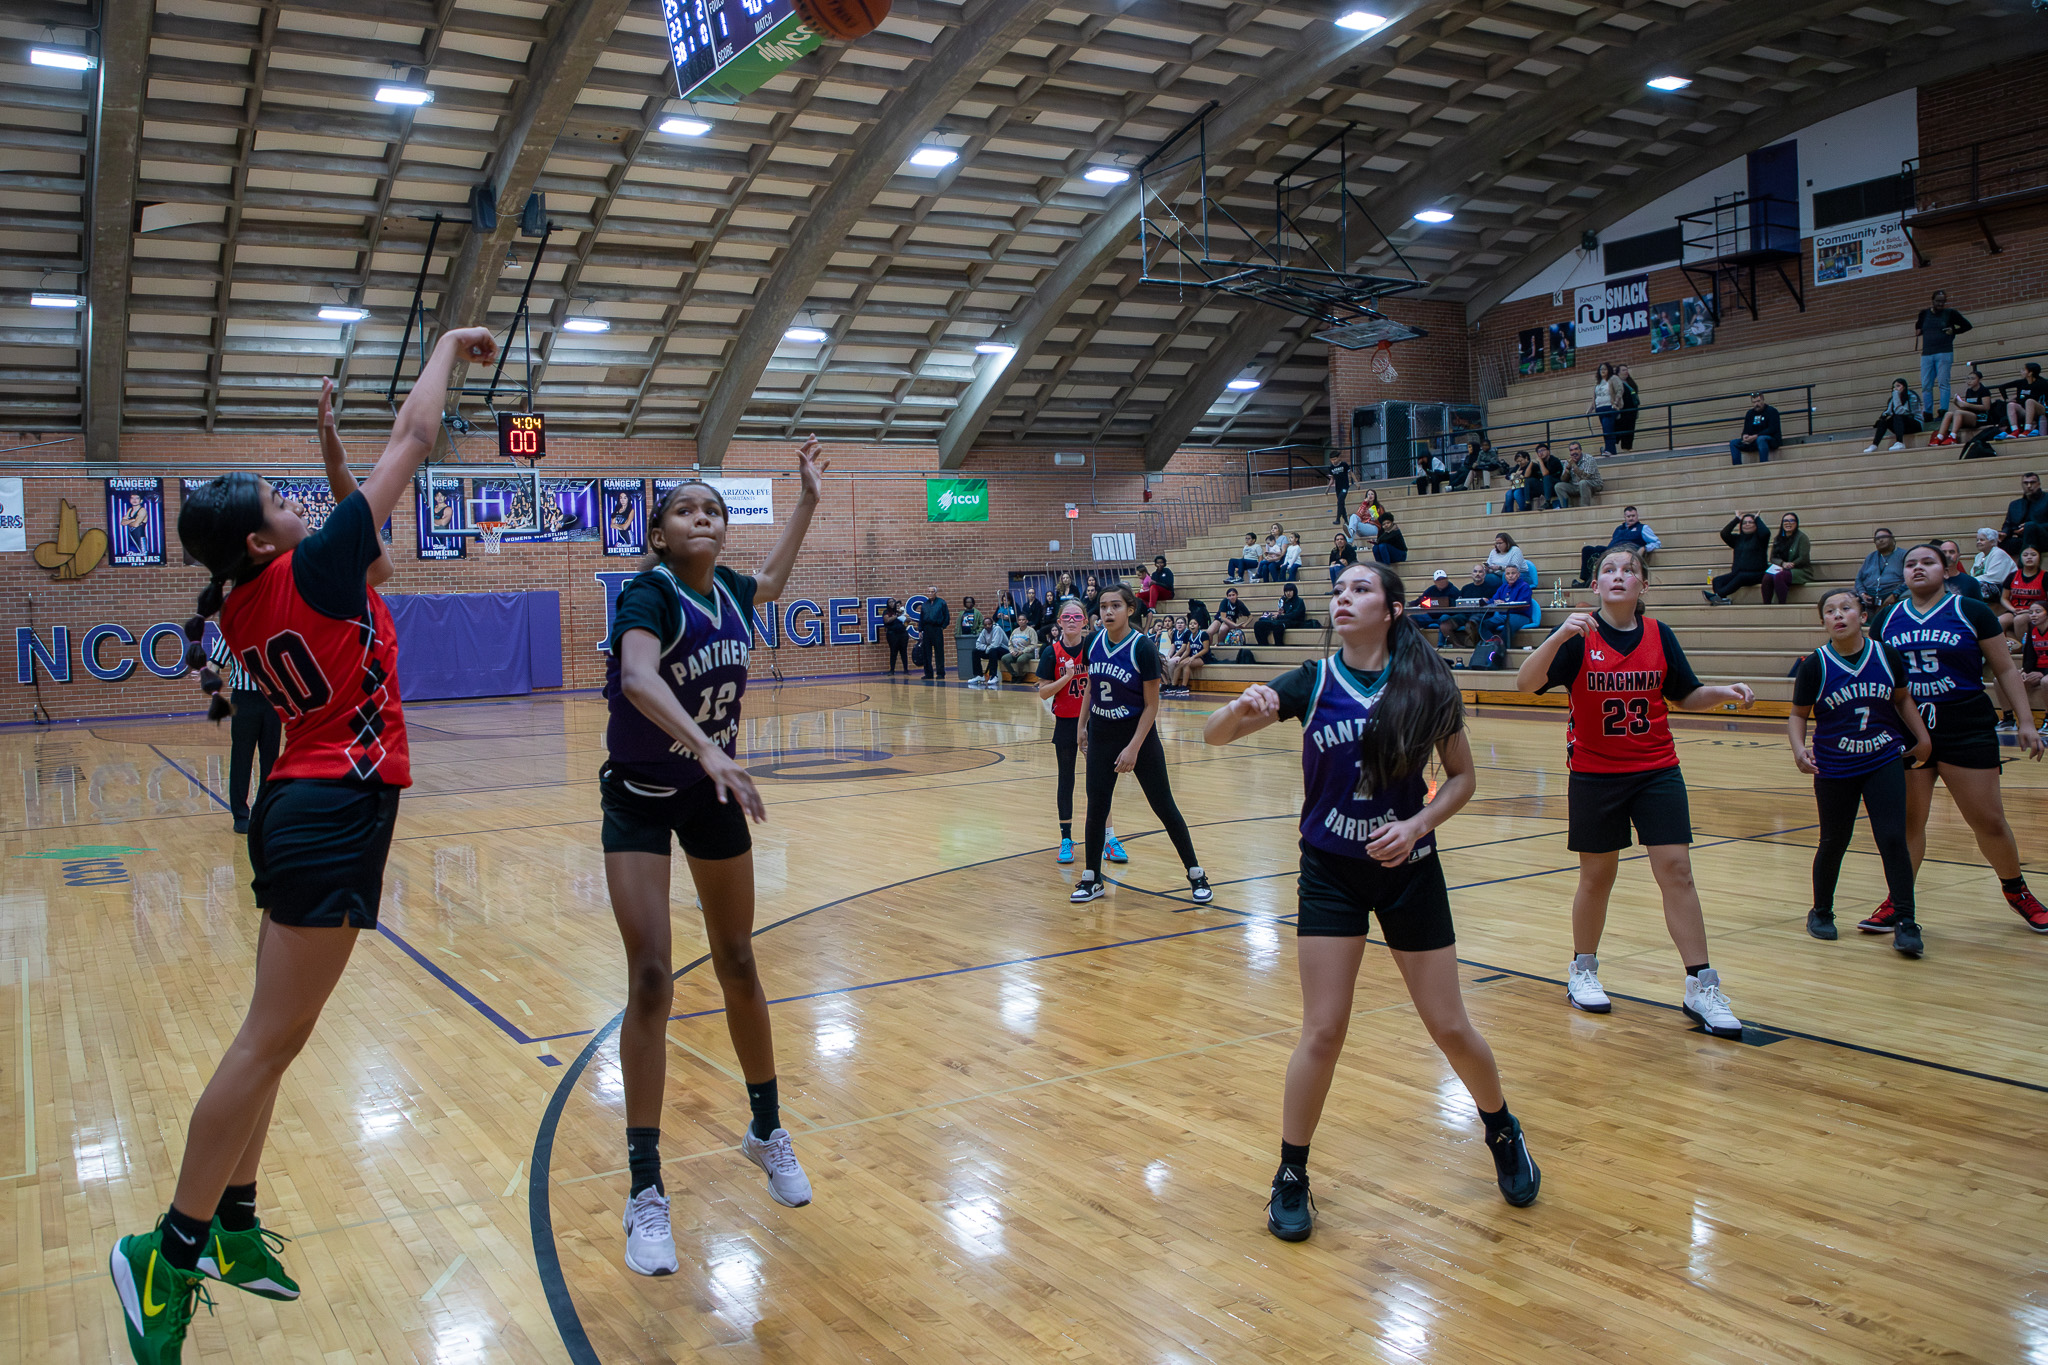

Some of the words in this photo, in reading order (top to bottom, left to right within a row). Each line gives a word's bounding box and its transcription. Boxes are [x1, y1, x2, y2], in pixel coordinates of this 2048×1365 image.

[669, 17, 683, 43] 23
[754, 12, 773, 34] MATCH
[717, 43, 734, 63] SCORE
[1817, 227, 1877, 246] Community
[1579, 295, 1602, 303] RINCON
[1606, 281, 1648, 309] SNACK
[1578, 325, 1605, 333] UNIVERSITY
[1608, 310, 1648, 334] BAR
[512, 417, 541, 429] 4:04
[510, 431, 536, 452] 00
[110, 480, 157, 488] RANGERS
[953, 495, 980, 504] ICCU
[1903, 649, 1940, 674] 15
[240, 629, 333, 720] 40
[1586, 670, 1663, 692] DRACHMAN
[1099, 681, 1113, 701] 2
[1824, 682, 1893, 710] PANTHERS
[693, 681, 737, 725] 12
[1091, 704, 1130, 720] GARDENS
[1602, 697, 1650, 736] 23
[1854, 706, 1870, 731] 7
[1838, 730, 1894, 753] GARDENS
